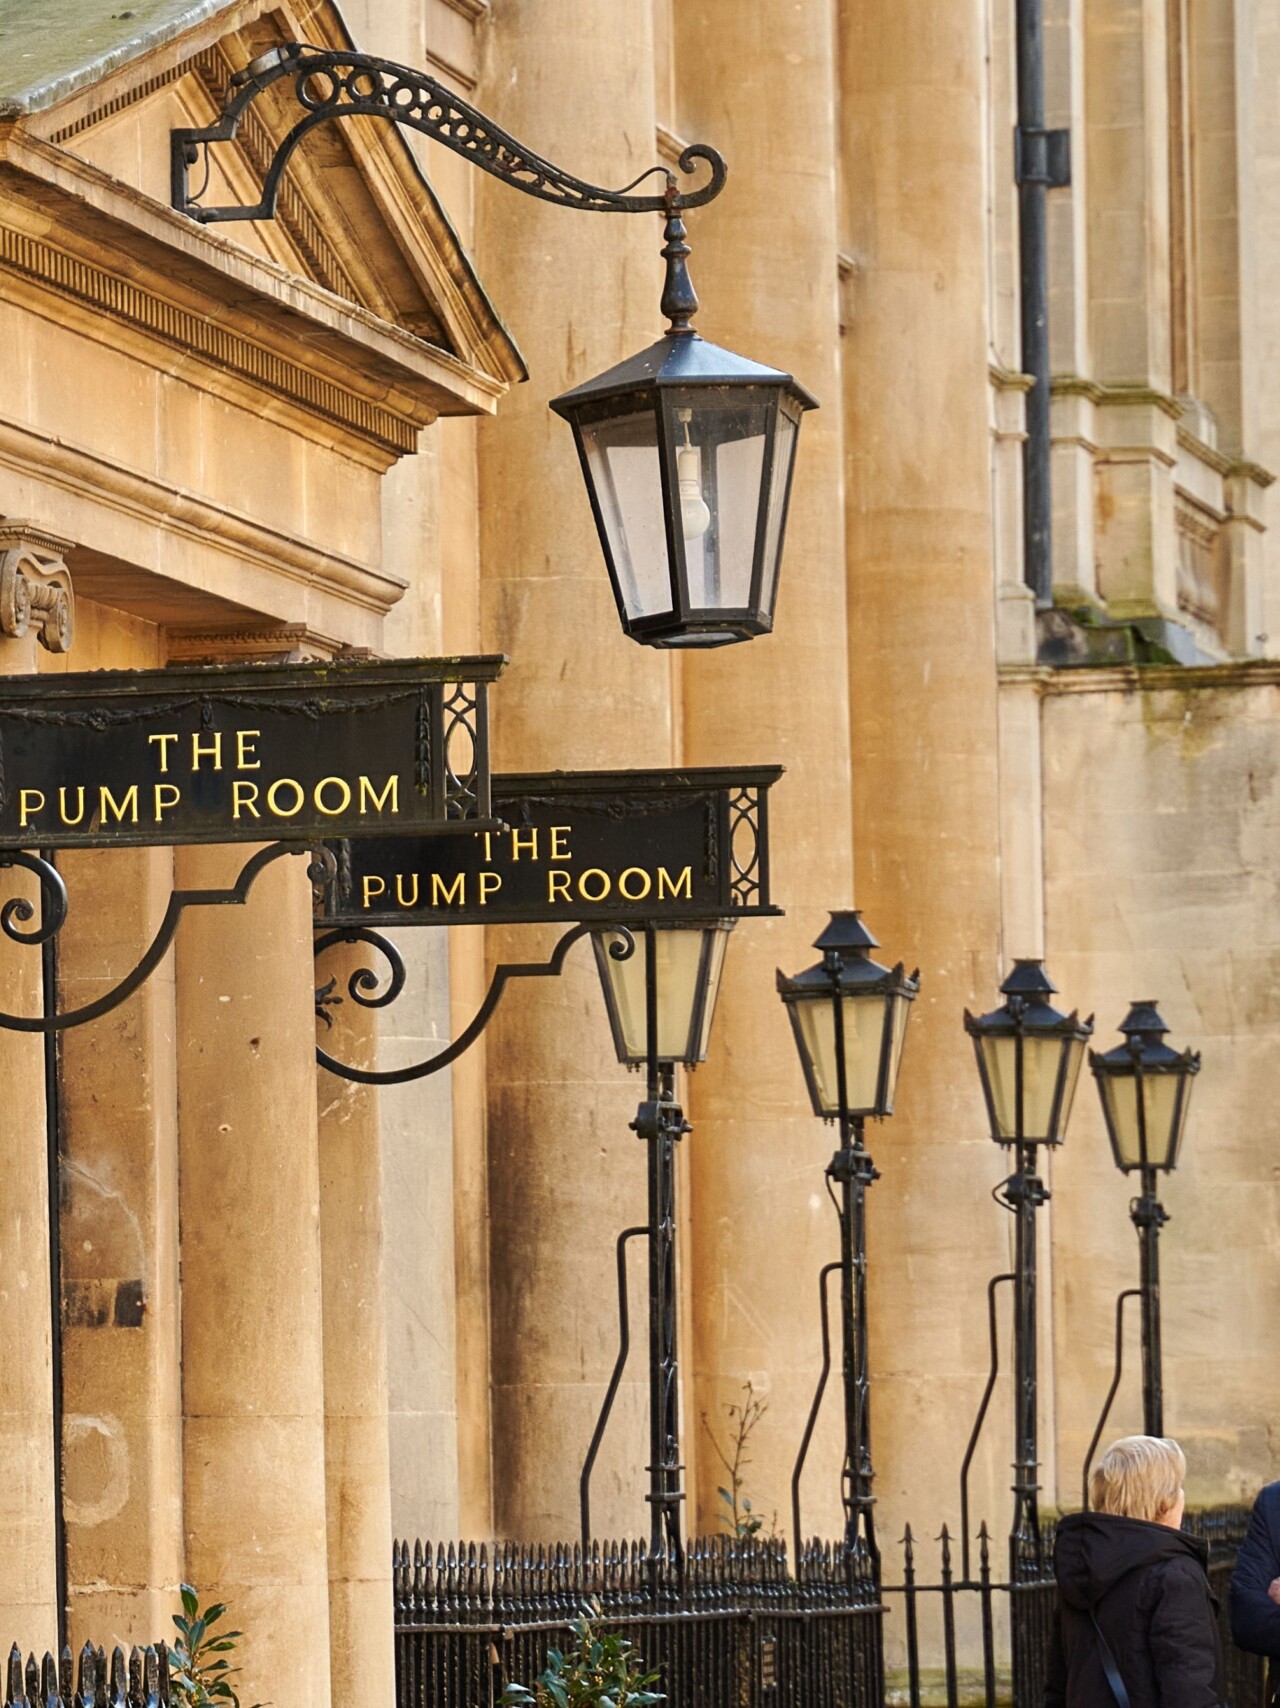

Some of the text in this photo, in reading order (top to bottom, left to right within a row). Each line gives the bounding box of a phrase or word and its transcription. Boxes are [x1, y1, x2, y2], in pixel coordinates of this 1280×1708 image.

[148, 730, 262, 773] THE
[19, 774, 400, 827] PUMP ROOM
[474, 826, 572, 862] THE
[362, 866, 692, 907] PUMP ROOM
